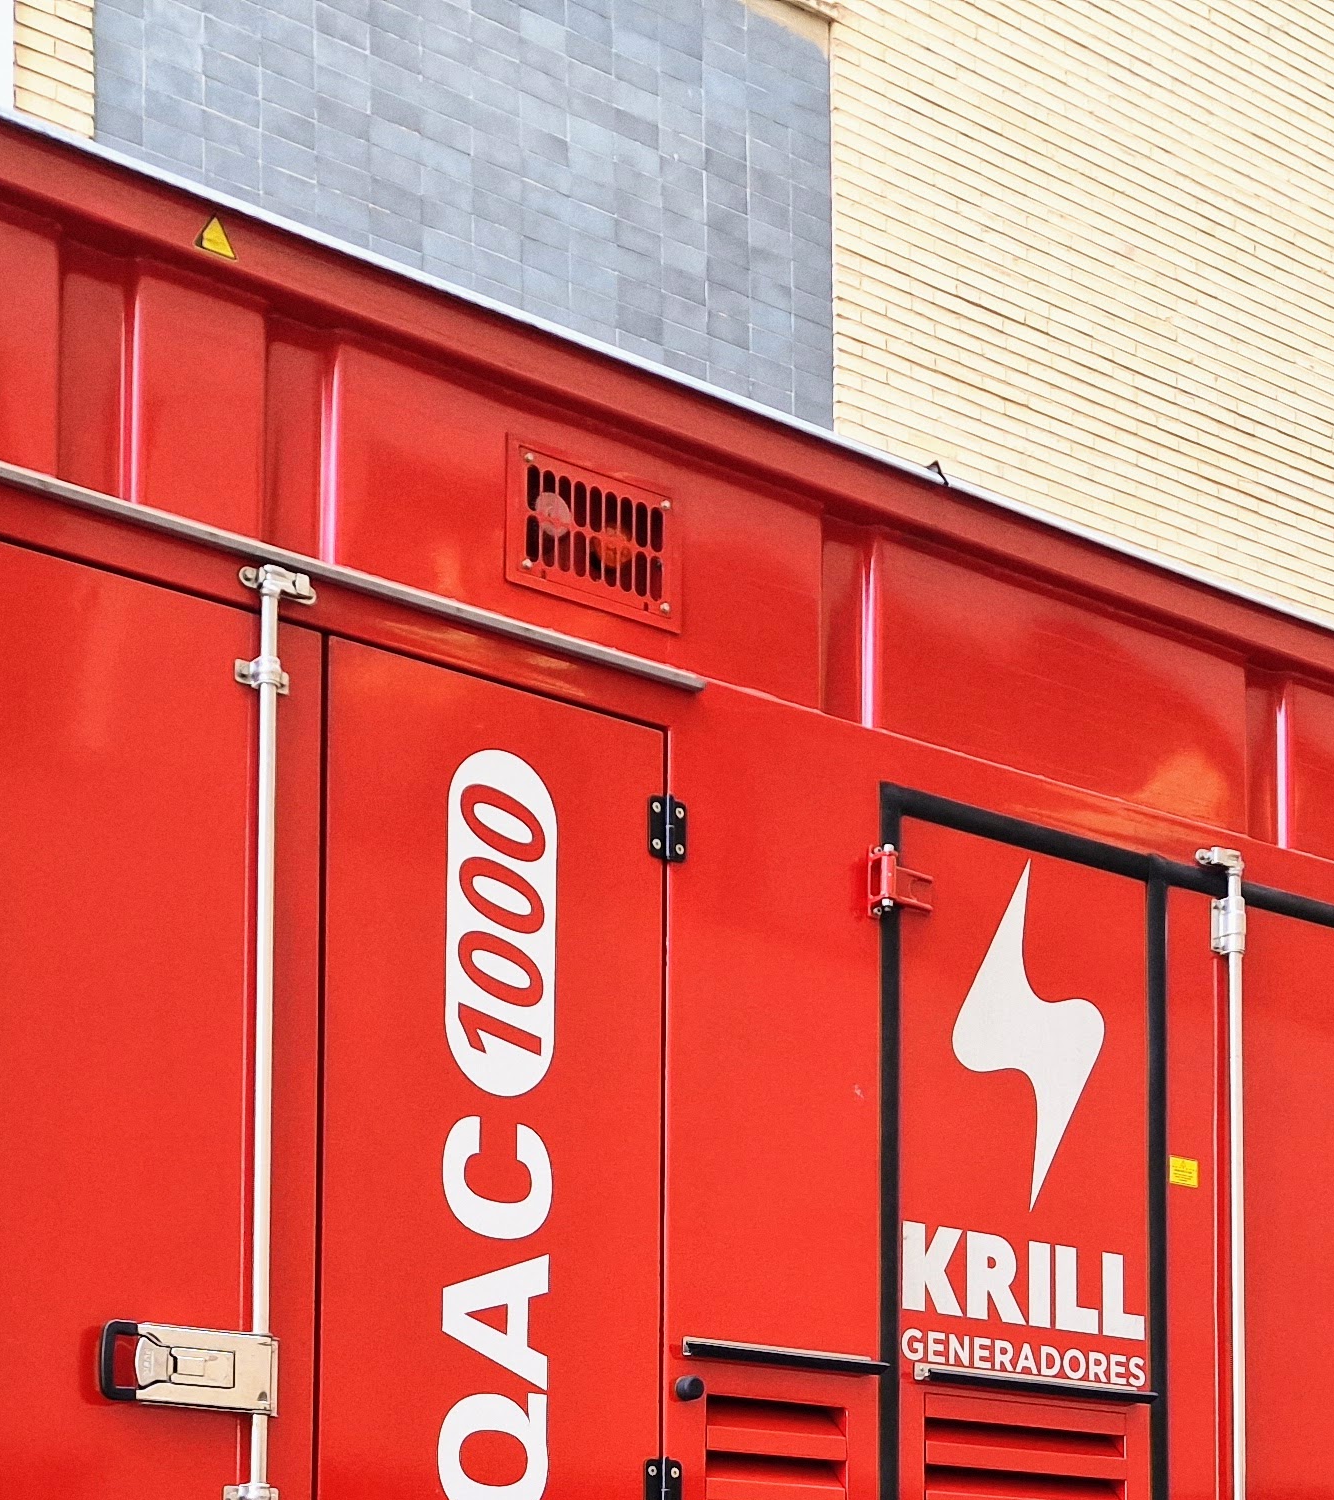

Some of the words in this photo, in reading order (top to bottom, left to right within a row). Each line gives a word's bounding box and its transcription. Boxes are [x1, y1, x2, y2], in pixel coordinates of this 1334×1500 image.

[458, 782, 546, 1057] 1000
[902, 1220, 1145, 1340] KRILL
[901, 1328, 1146, 1387] GENERADORES
